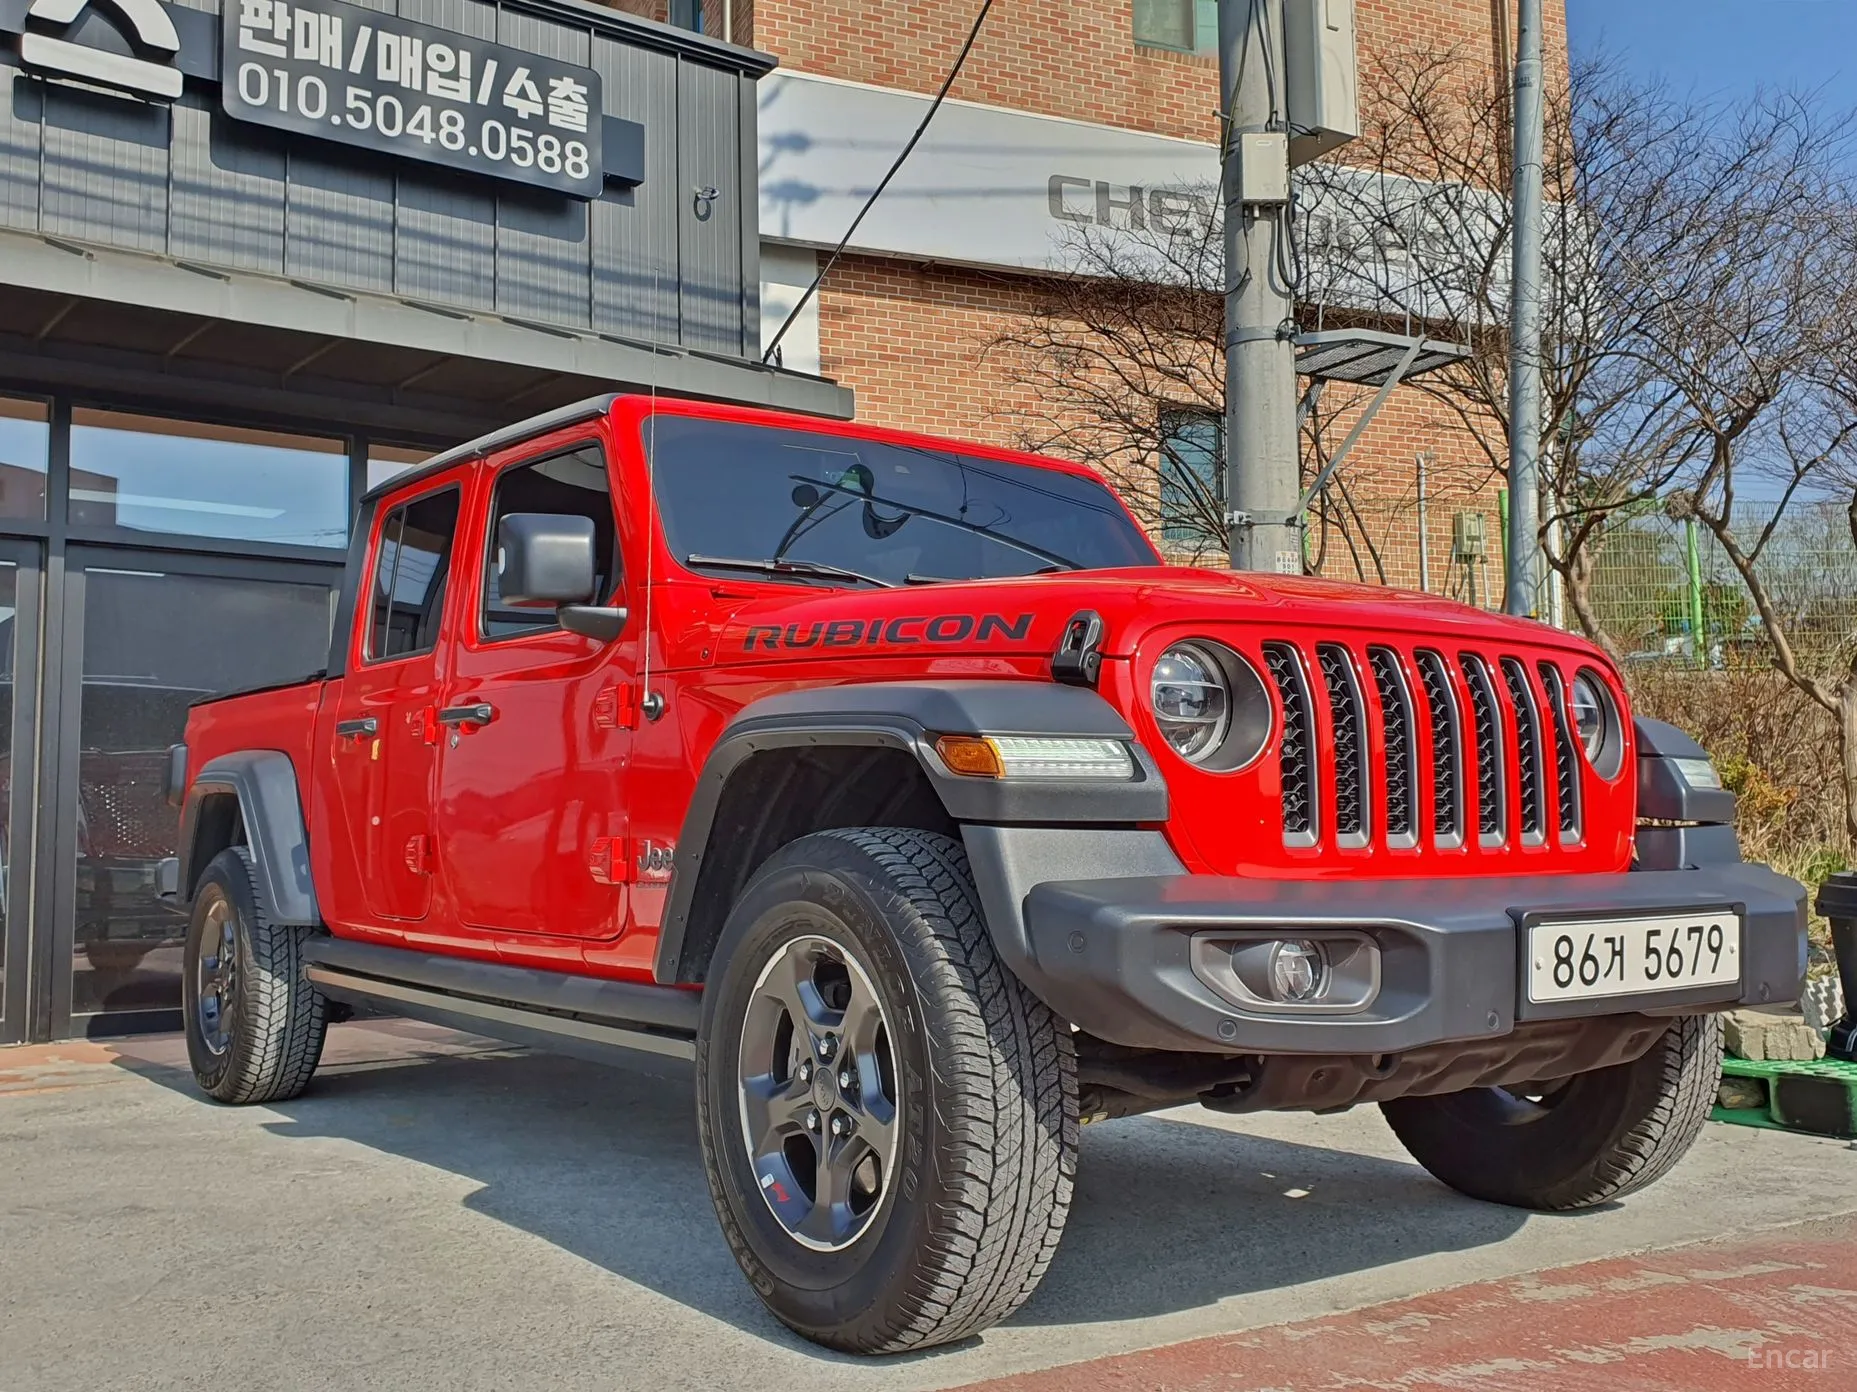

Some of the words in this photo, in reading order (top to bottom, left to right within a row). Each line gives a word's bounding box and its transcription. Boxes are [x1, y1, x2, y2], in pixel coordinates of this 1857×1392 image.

[238, 0, 589, 133] 판매/매입/수출
[238, 62, 590, 180] 010.5048.0588
[743, 612, 1036, 652] RUBICON
[637, 839, 674, 871] Jee
[1552, 933, 1625, 989] 86거
[1644, 924, 1724, 981] 5679
